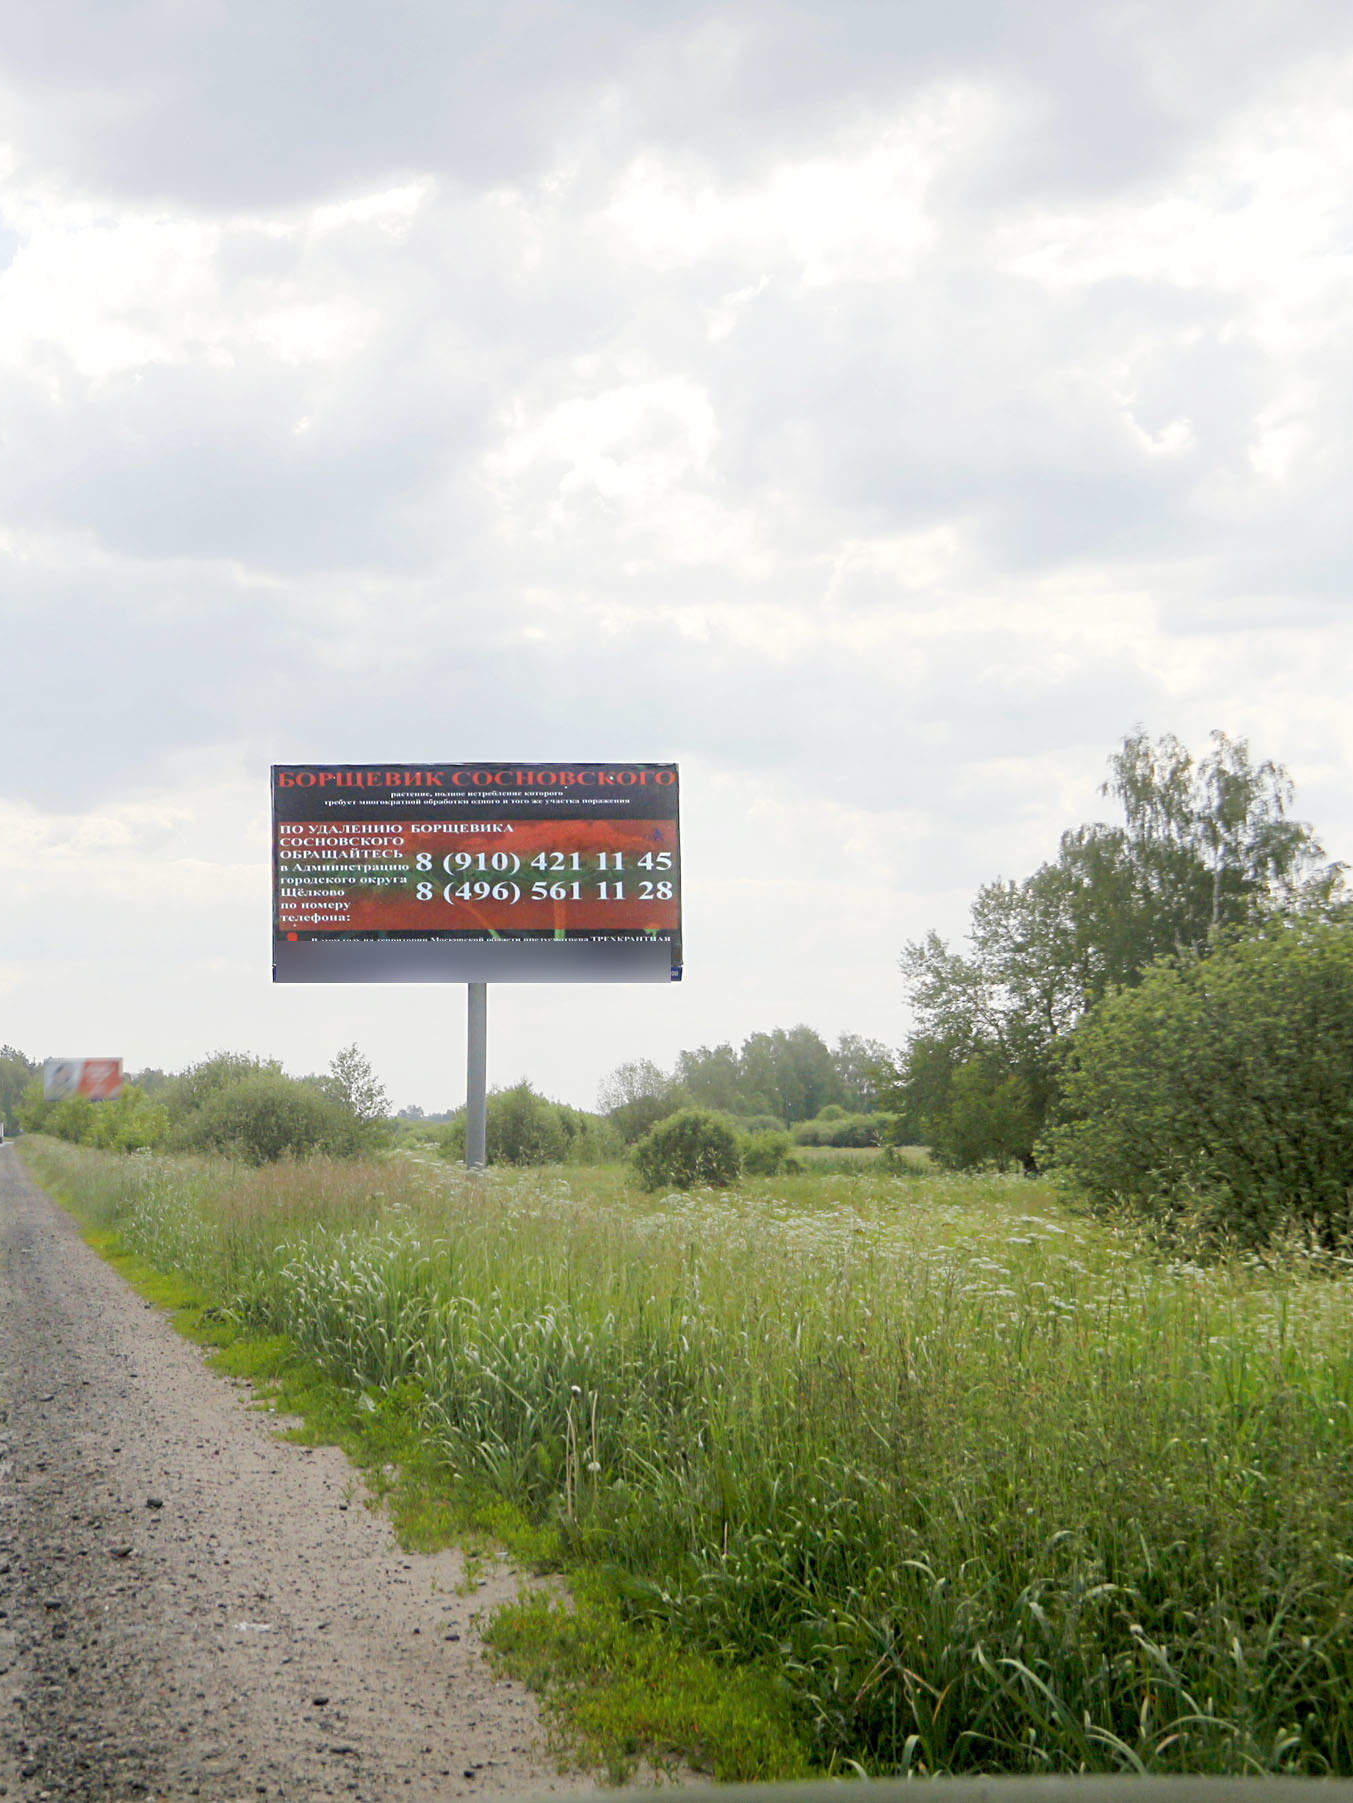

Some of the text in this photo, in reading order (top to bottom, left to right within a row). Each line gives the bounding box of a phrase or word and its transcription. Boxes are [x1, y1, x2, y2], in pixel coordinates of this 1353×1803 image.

[279, 770, 677, 789] БОРЩЕВИК СОСНОВСКОГО
[390, 792, 433, 800] растение,
[467, 790, 522, 798] истребление
[324, 799, 357, 808] требует
[359, 798, 422, 807] многократной
[423, 798, 469, 807] обработки
[280, 823, 514, 835] ПО УДАЛЕНИЮ БОРЩЕВИКА
[279, 836, 405, 847] СОСНОВСКОГО
[279, 847, 404, 860] ОБРАЩАЙТЕСЬ
[292, 863, 410, 874] Администрацию
[415, 851, 673, 876] 8 (910) 421 11 45
[280, 876, 408, 886] городского округа
[280, 887, 345, 898] Щёлково
[415, 881, 673, 905] 8 (496) 561 11 28
[280, 902, 351, 911] по номеру
[279, 912, 352, 924] телефона:
